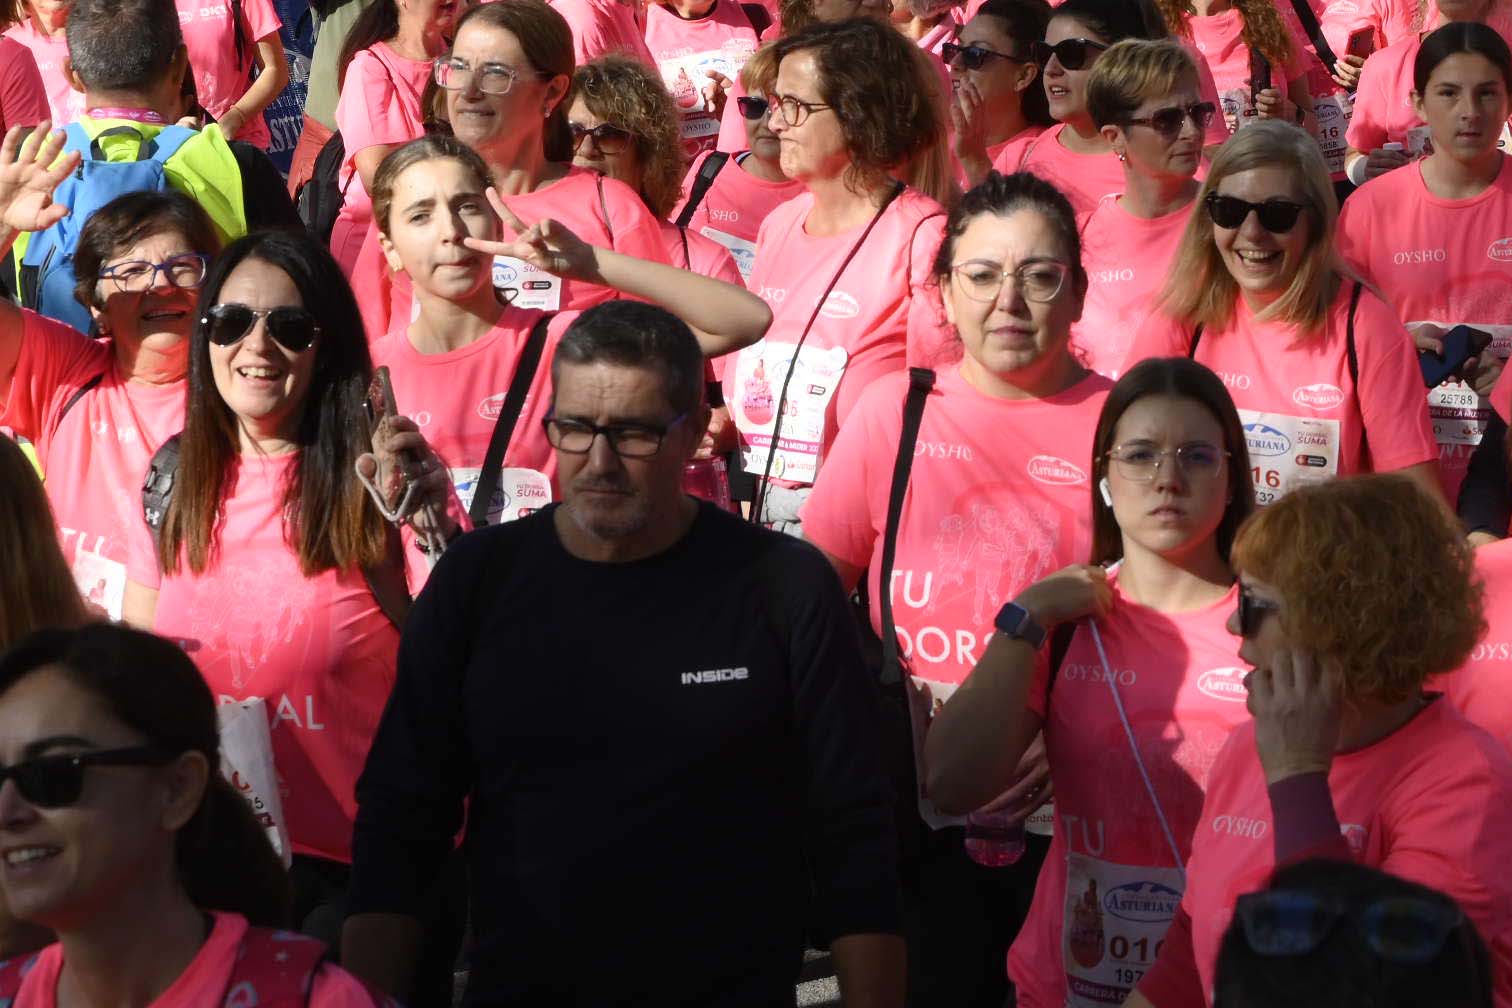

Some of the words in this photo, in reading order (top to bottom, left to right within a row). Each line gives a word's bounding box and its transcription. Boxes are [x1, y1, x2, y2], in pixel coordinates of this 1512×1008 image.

[1321, 127, 1339, 139] 16
[1393, 248, 1447, 264] OYSHO
[1440, 393, 1473, 405] 25788
[1297, 436, 1328, 446] SUMA
[914, 440, 975, 462] OYSHO
[1030, 462, 1086, 483] ASTURIANA
[1250, 467, 1281, 488] 16
[516, 489, 547, 498] SUMA
[1256, 490, 1274, 504] 32
[1065, 664, 1138, 687] OYSHO
[1062, 815, 1106, 857] TU
[1212, 815, 1267, 839] OYSHO
[1107, 894, 1176, 914] ASTURIAN
[1115, 969, 1143, 985] 197
